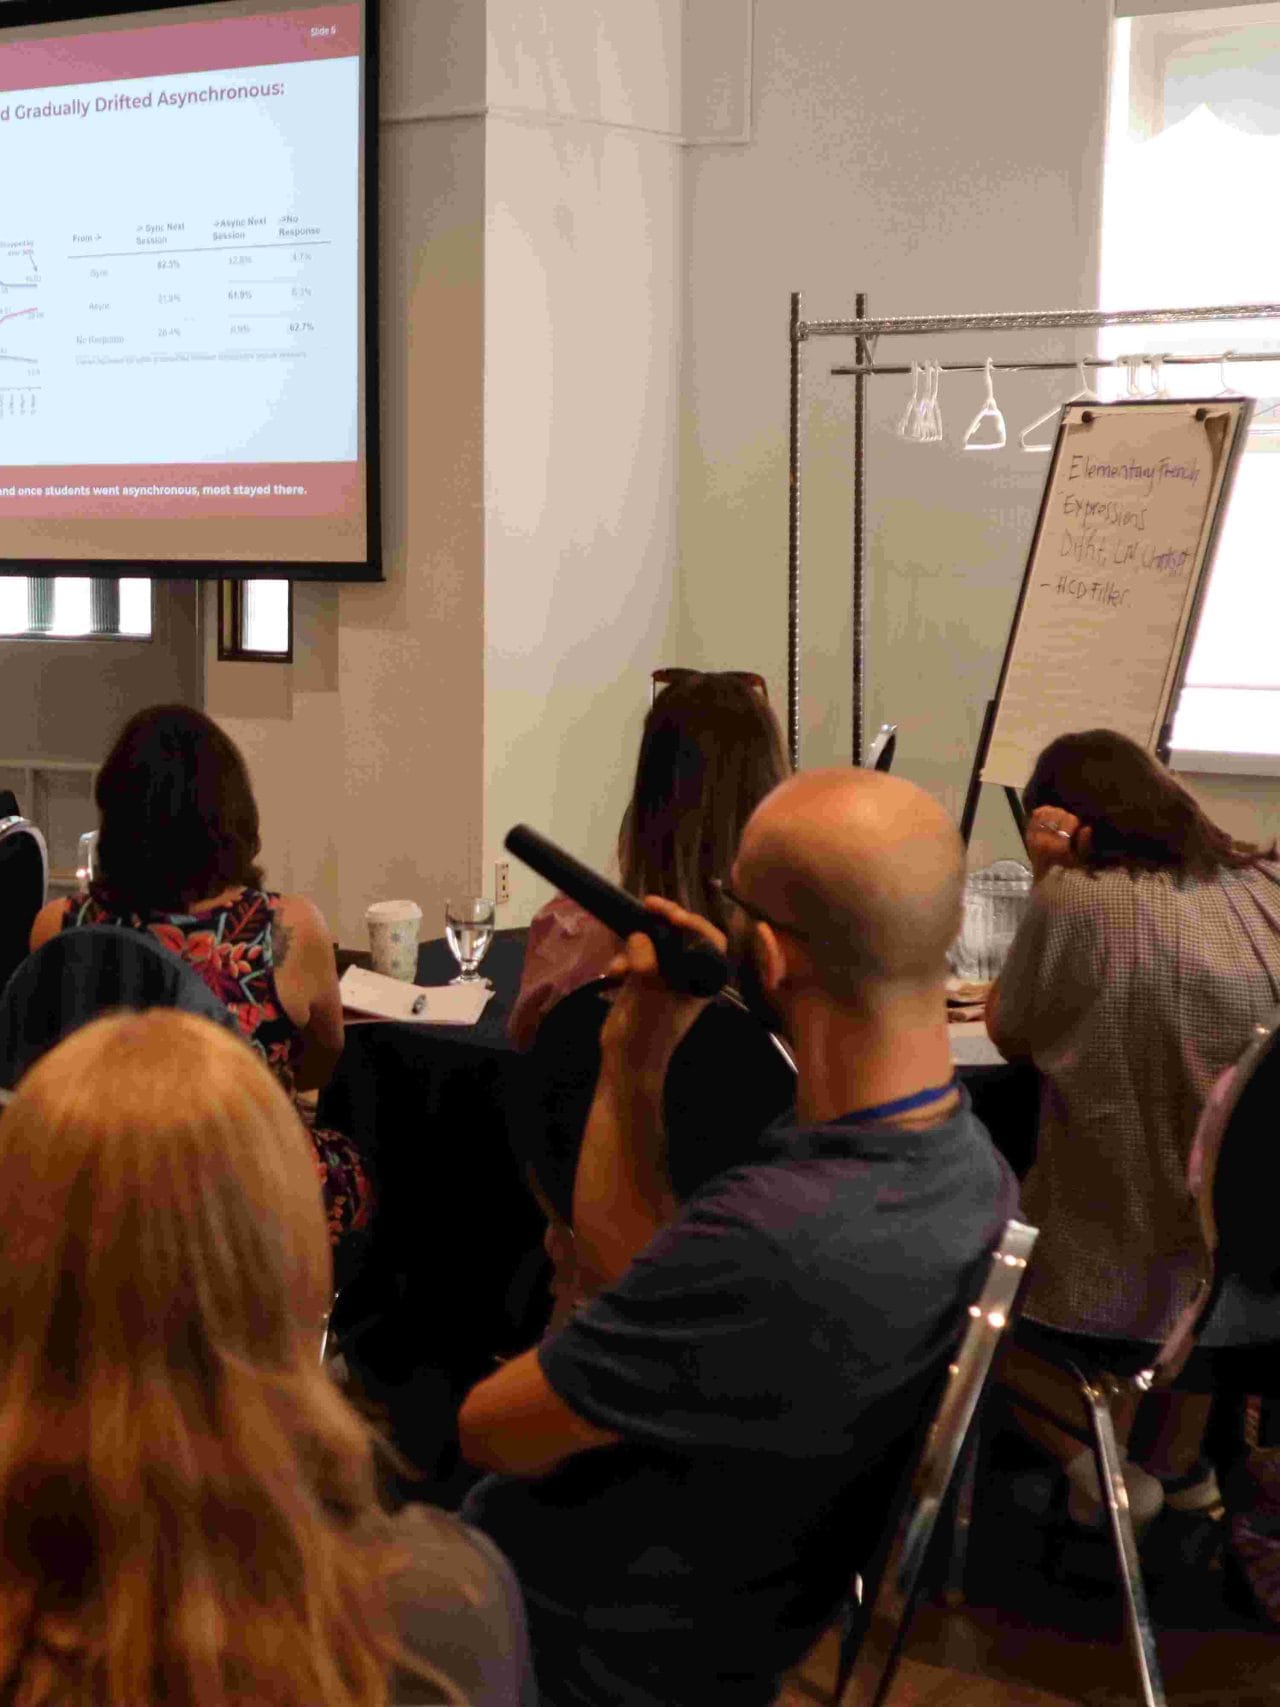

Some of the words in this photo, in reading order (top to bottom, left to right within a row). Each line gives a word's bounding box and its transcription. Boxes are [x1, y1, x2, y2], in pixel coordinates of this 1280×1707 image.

[310, 25, 330, 37] Slide
[15, 98, 91, 120] Gradually
[95, 91, 152, 113] Drifted
[157, 81, 285, 109] Asynchronous:
[18, 487, 42, 497] once
[45, 485, 90, 496] students
[93, 486, 120, 496] went
[122, 485, 200, 498] asynchronous,
[202, 485, 231, 495] most
[233, 485, 271, 498] stayed
[273, 485, 308, 496] there.
